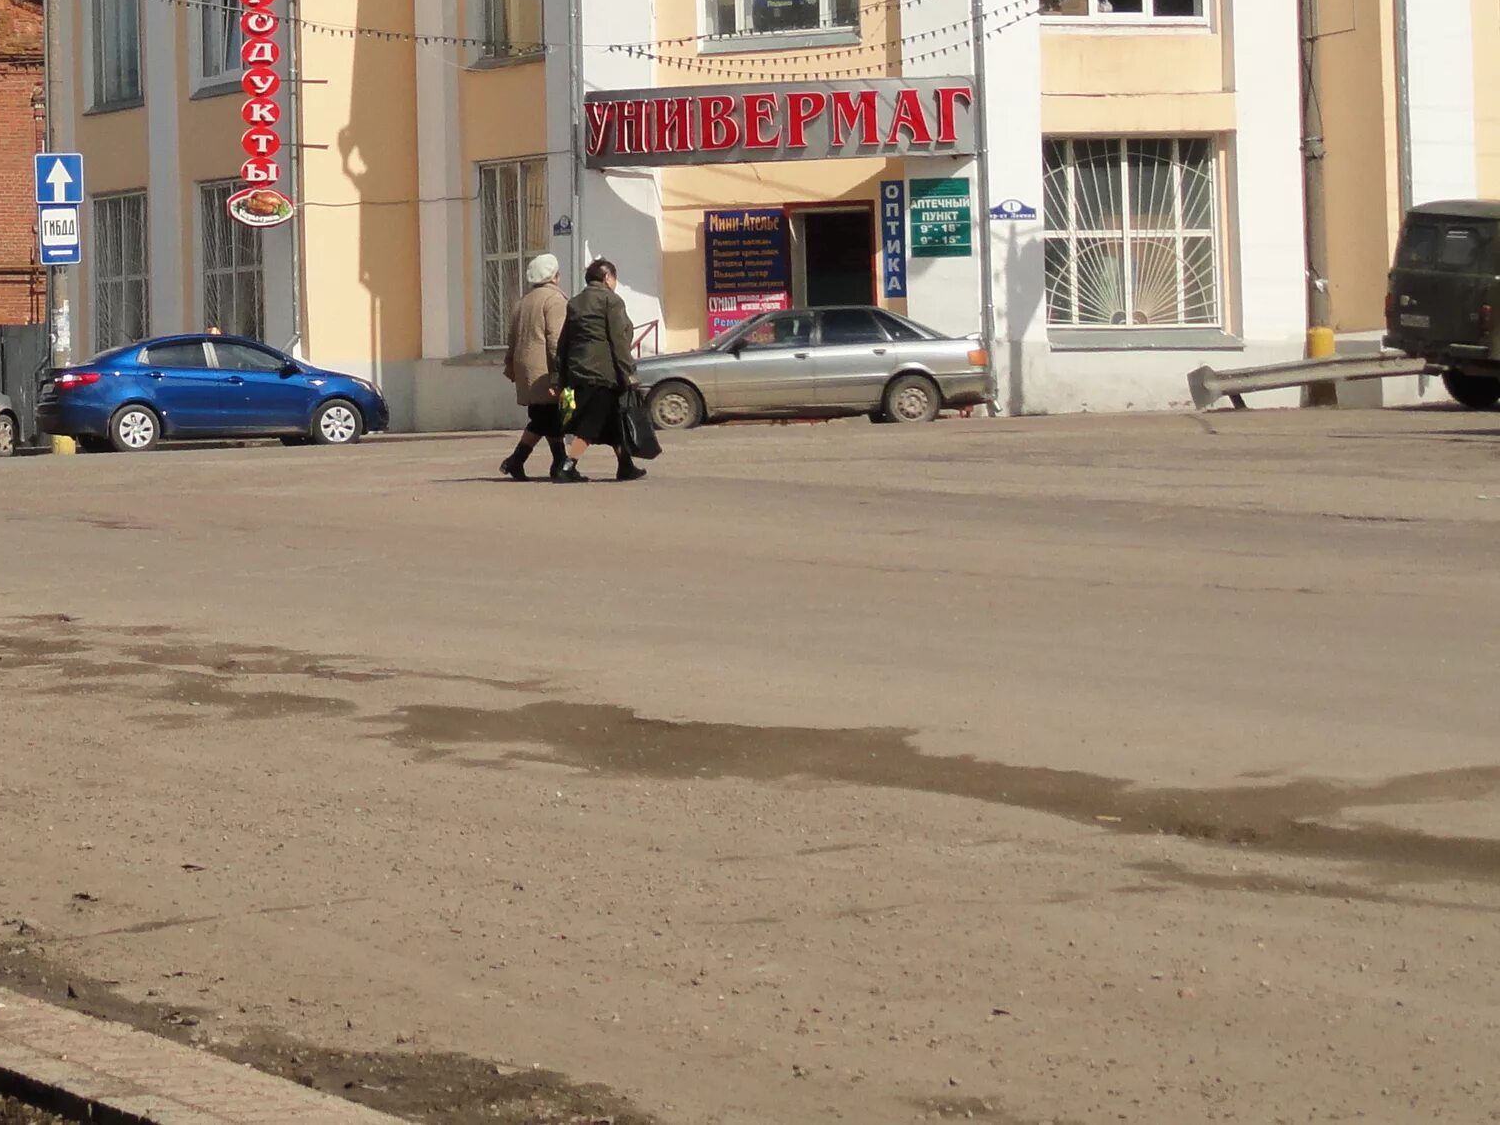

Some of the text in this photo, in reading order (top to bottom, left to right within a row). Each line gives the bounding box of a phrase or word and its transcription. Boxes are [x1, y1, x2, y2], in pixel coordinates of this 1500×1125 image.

[583, 85, 973, 156] УНИВЕРМАГ
[910, 196, 971, 209] АПТЕЧНЫЙ
[709, 212, 780, 233] Мини-Ателье
[921, 211, 959, 221] ПУНКТ
[43, 219, 76, 236] ГИБДД
[885, 184, 902, 291] ОПТИКА
[708, 296, 737, 312] СУМКИ
